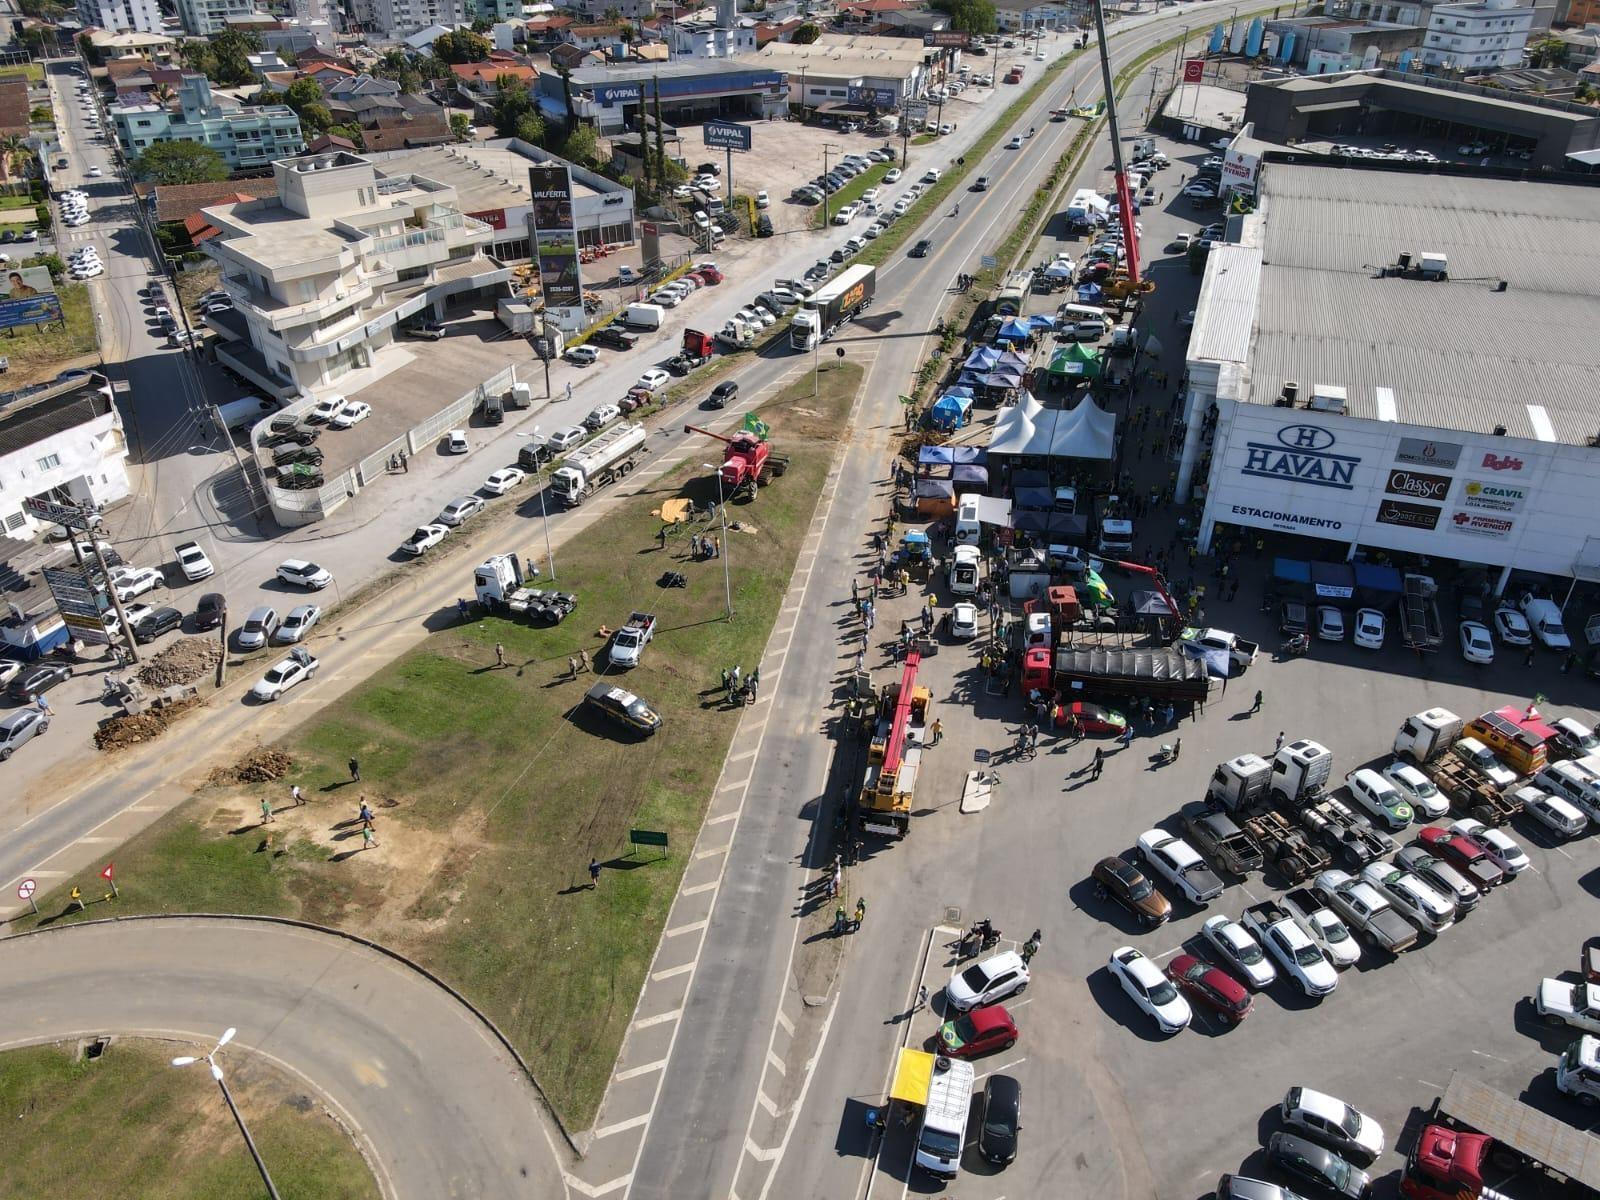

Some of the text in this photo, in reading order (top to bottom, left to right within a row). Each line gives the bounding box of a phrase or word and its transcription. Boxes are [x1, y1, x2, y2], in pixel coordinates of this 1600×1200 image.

[613, 88, 640, 98] VIPAL
[716, 127, 744, 138] VIPAL
[1294, 427, 1319, 448] H
[1244, 447, 1359, 484] HAVAN
[1481, 452, 1524, 471] Bob's
[1391, 472, 1446, 498] Classic
[1483, 487, 1524, 499] CRAVIL
[28, 498, 48, 512] HG
[1232, 505, 1342, 530] ESTACIONAMENTO
